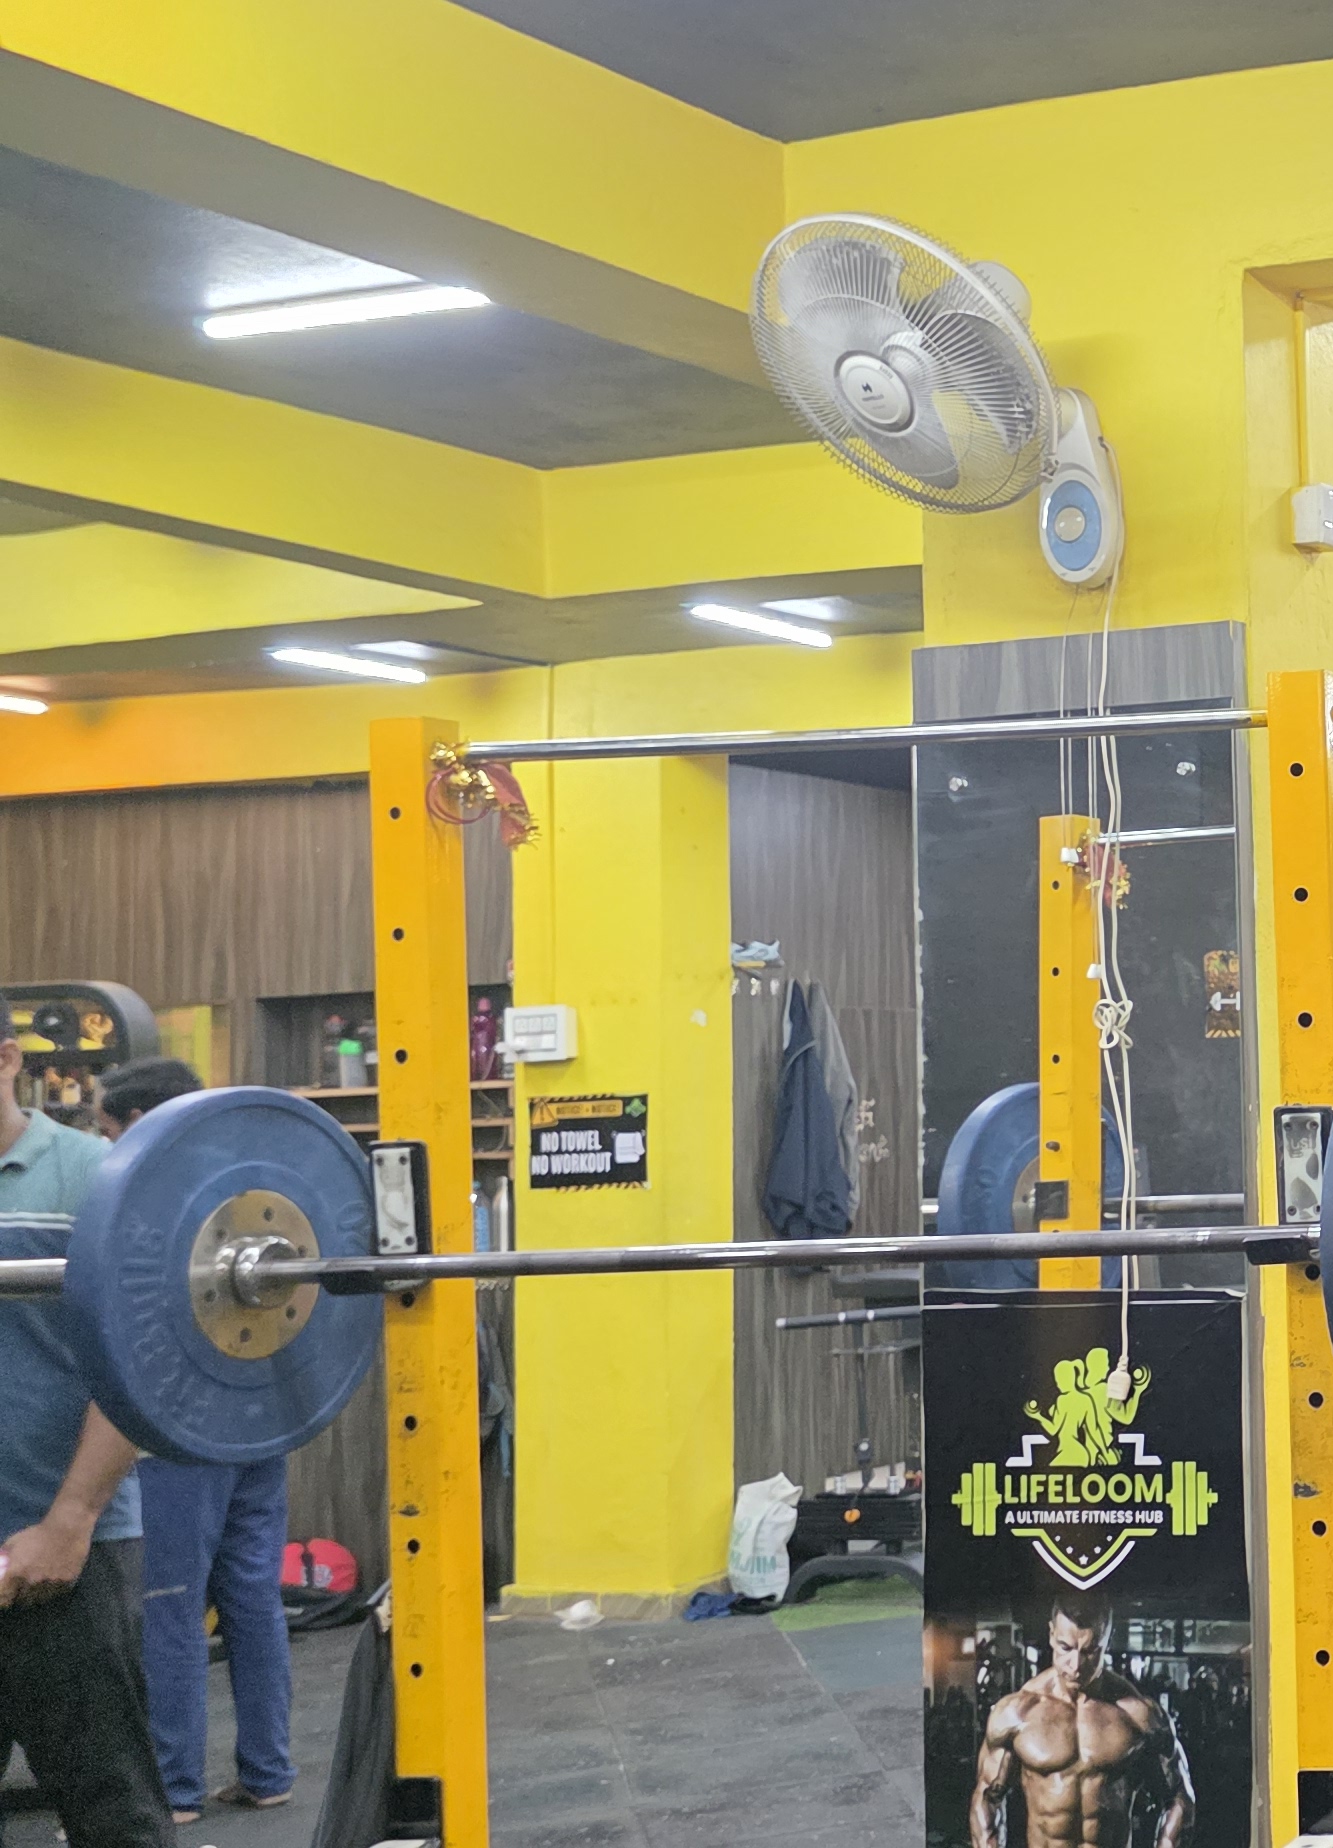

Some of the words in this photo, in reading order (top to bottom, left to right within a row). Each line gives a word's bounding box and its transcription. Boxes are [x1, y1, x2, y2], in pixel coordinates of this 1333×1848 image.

[541, 1131, 559, 1153] NO
[560, 1129, 602, 1152] TOWEL
[531, 1154, 549, 1176] NO
[550, 1151, 612, 1175] WORKOUT
[1004, 1473, 1163, 1504] LIFELOOM
[1005, 1511, 1015, 1524] A
[1017, 1510, 1079, 1524] ULTIMATE
[1081, 1510, 1133, 1524] FITNESS
[1135, 1510, 1163, 1524] HUB
